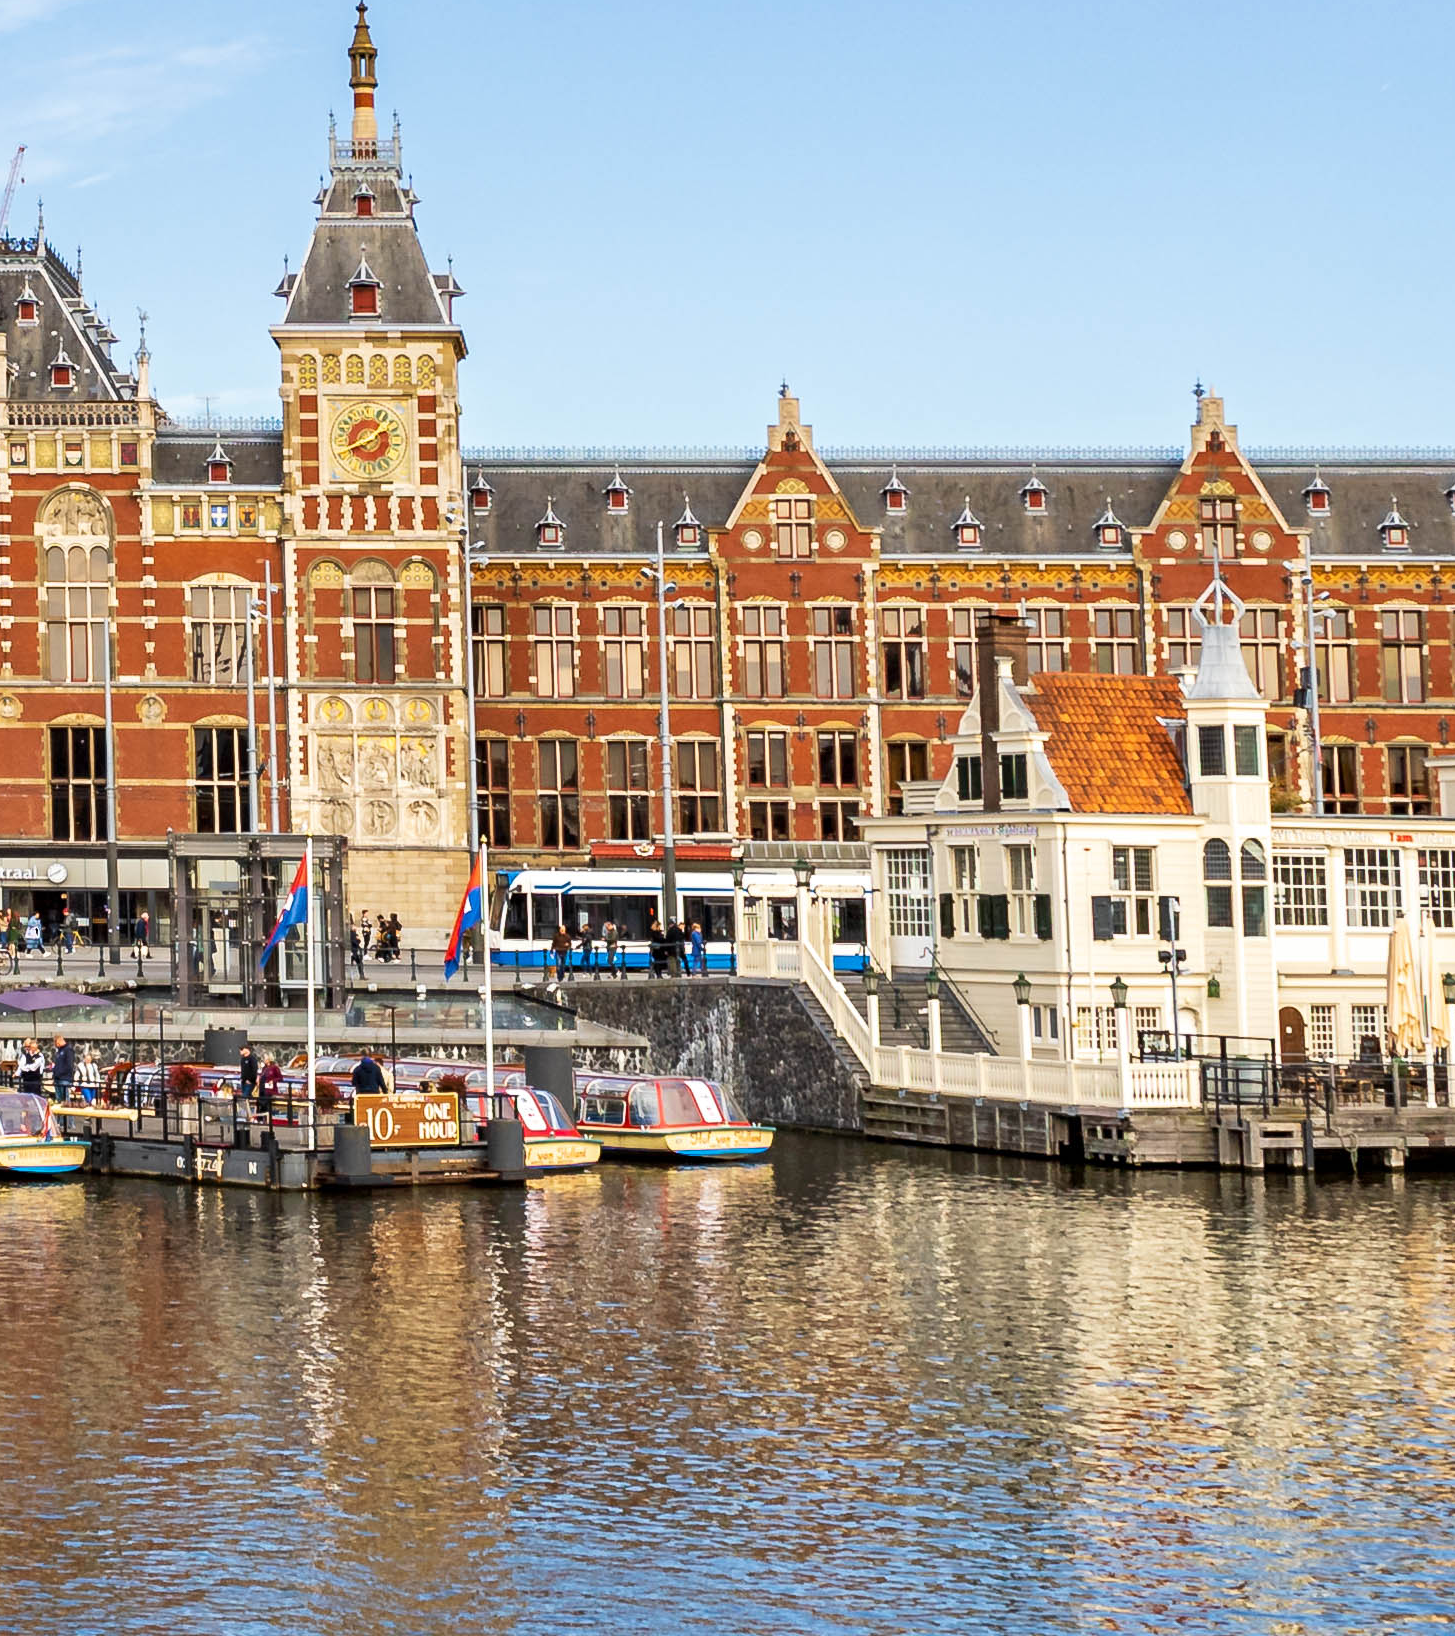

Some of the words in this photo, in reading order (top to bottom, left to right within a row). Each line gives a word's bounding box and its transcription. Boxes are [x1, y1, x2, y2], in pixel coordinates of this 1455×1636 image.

[423, 1102, 452, 1121] ONE
[418, 1120, 458, 1140] HOUR
[248, 1161, 258, 1175] N
